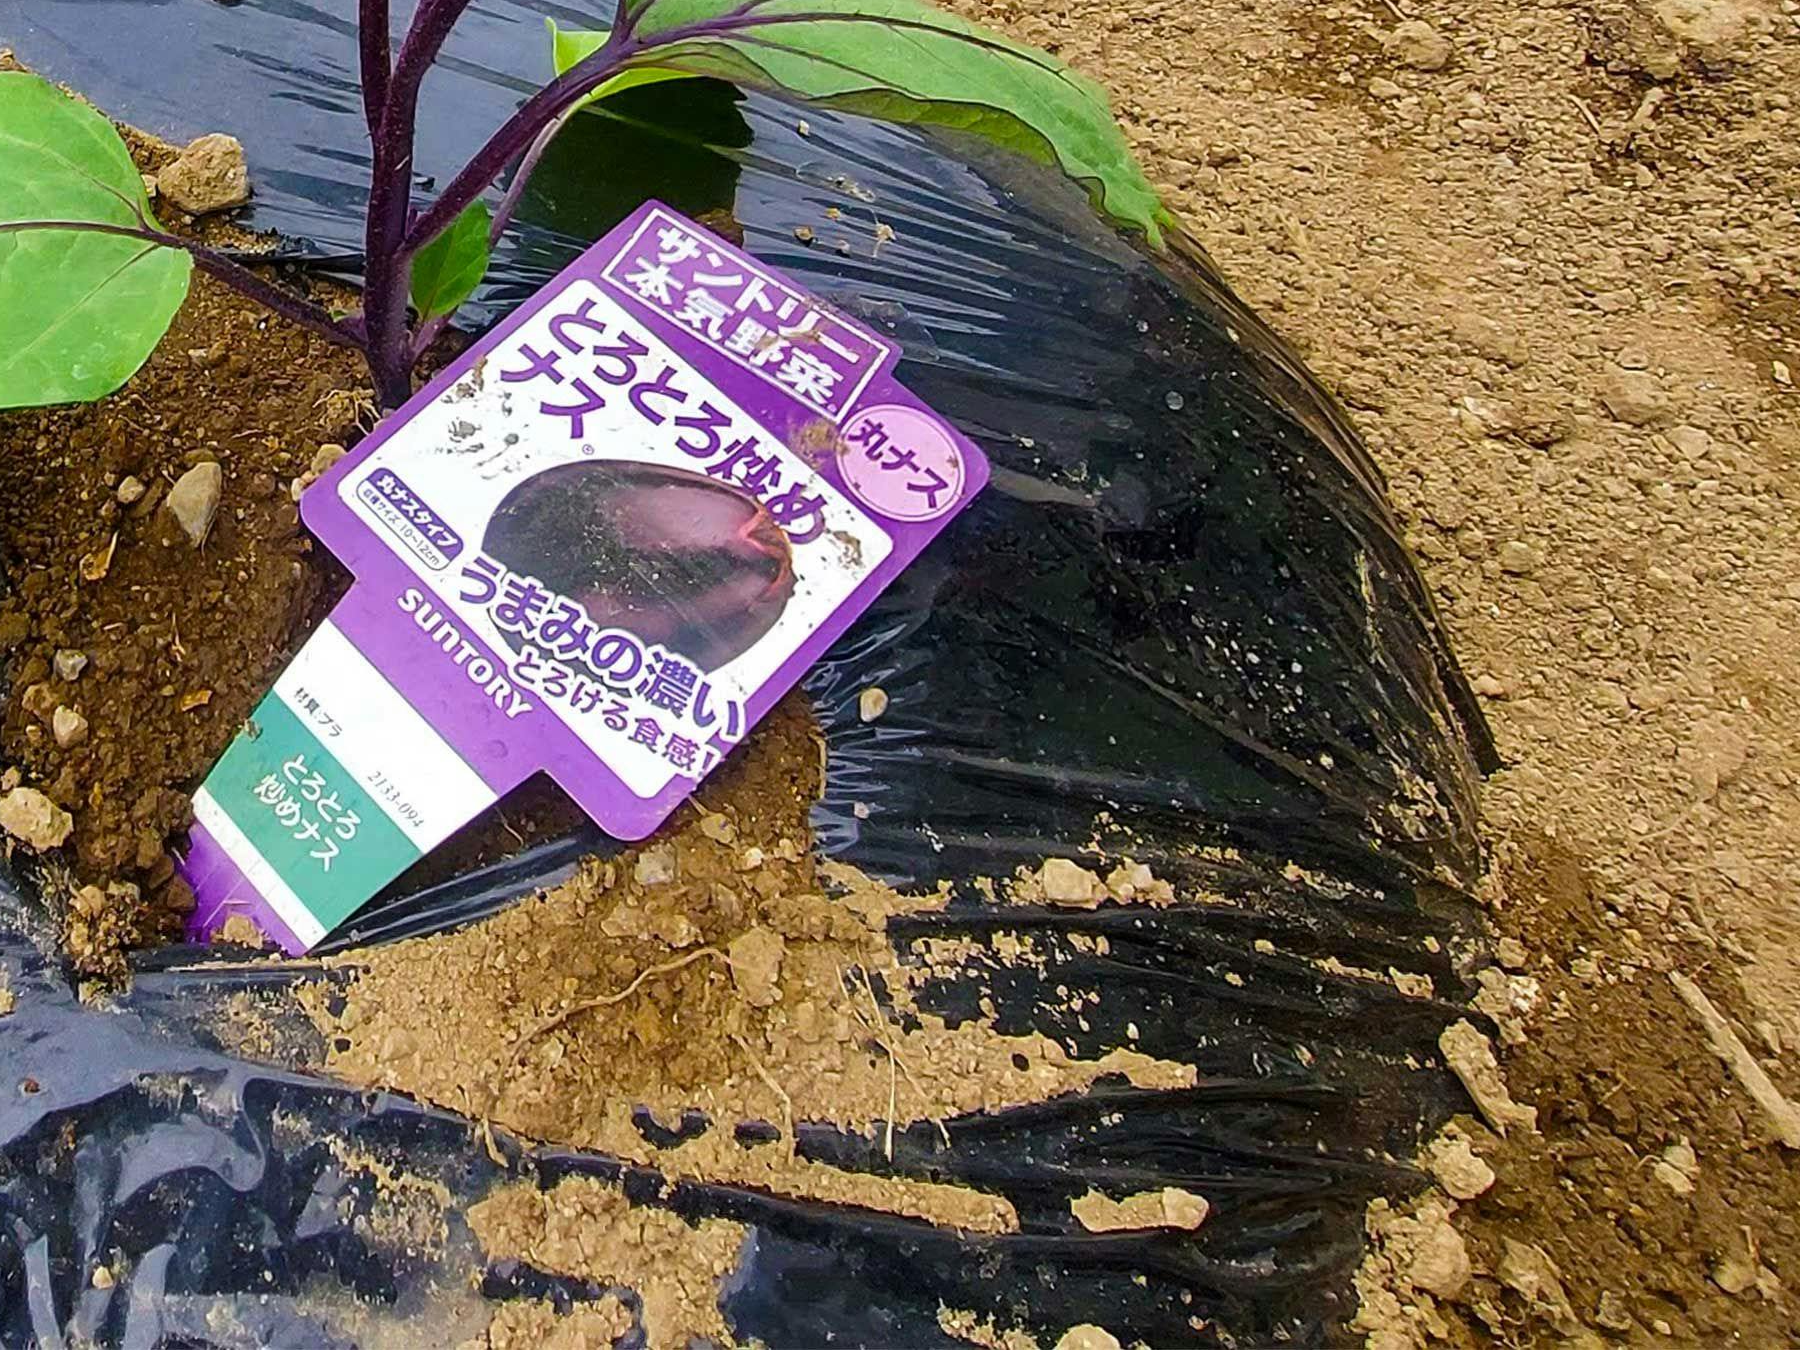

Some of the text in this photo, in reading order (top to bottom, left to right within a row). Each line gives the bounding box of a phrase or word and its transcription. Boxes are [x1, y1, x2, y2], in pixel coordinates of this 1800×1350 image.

[623, 256, 844, 404] 本気野菜
[655, 227, 862, 364] サントリー
[499, 343, 606, 440] ナス
[547, 297, 829, 544] とろとろ炒め
[376, 474, 459, 547] 丸ナスタイプ
[847, 418, 950, 510] 丸ナス
[397, 587, 534, 719] SUNTORY
[459, 556, 739, 737] うまみの濃い
[513, 649, 715, 777] とろける食感!
[253, 772, 340, 873] 炒めナス
[283, 753, 361, 841] とろとろ
[366, 770, 426, 828] 2133-094
